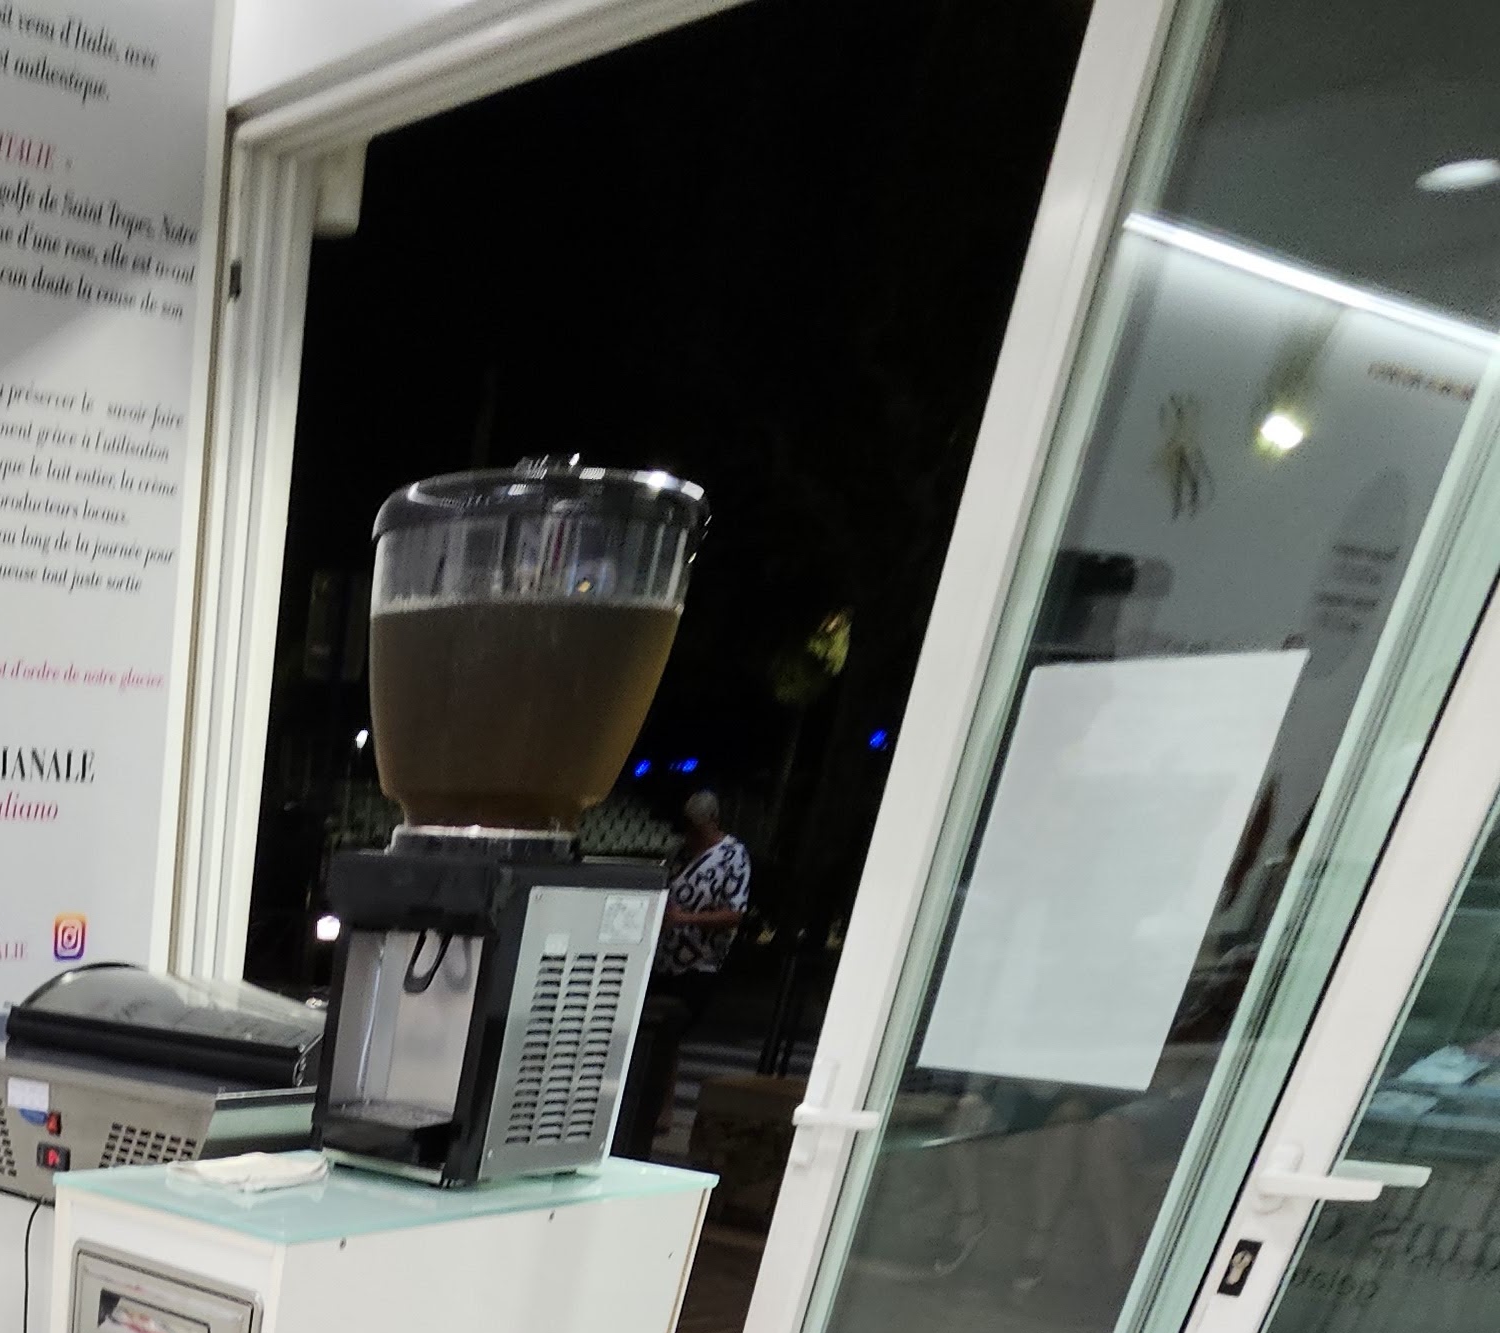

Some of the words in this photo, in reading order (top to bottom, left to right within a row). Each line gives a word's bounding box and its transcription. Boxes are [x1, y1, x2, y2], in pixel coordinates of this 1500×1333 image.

[102, 241, 127, 271] elle
[31, 265, 71, 296] doute
[76, 273, 92, 304] la
[0, 459, 24, 481] que
[29, 454, 42, 478] le
[46, 457, 71, 483] lait
[119, 468, 134, 491] la
[20, 524, 50, 554] long
[53, 529, 70, 553] de
[74, 531, 90, 556] la
[143, 547, 176, 570] pour
[69, 569, 101, 594] juste
[106, 575, 142, 593] sortie
